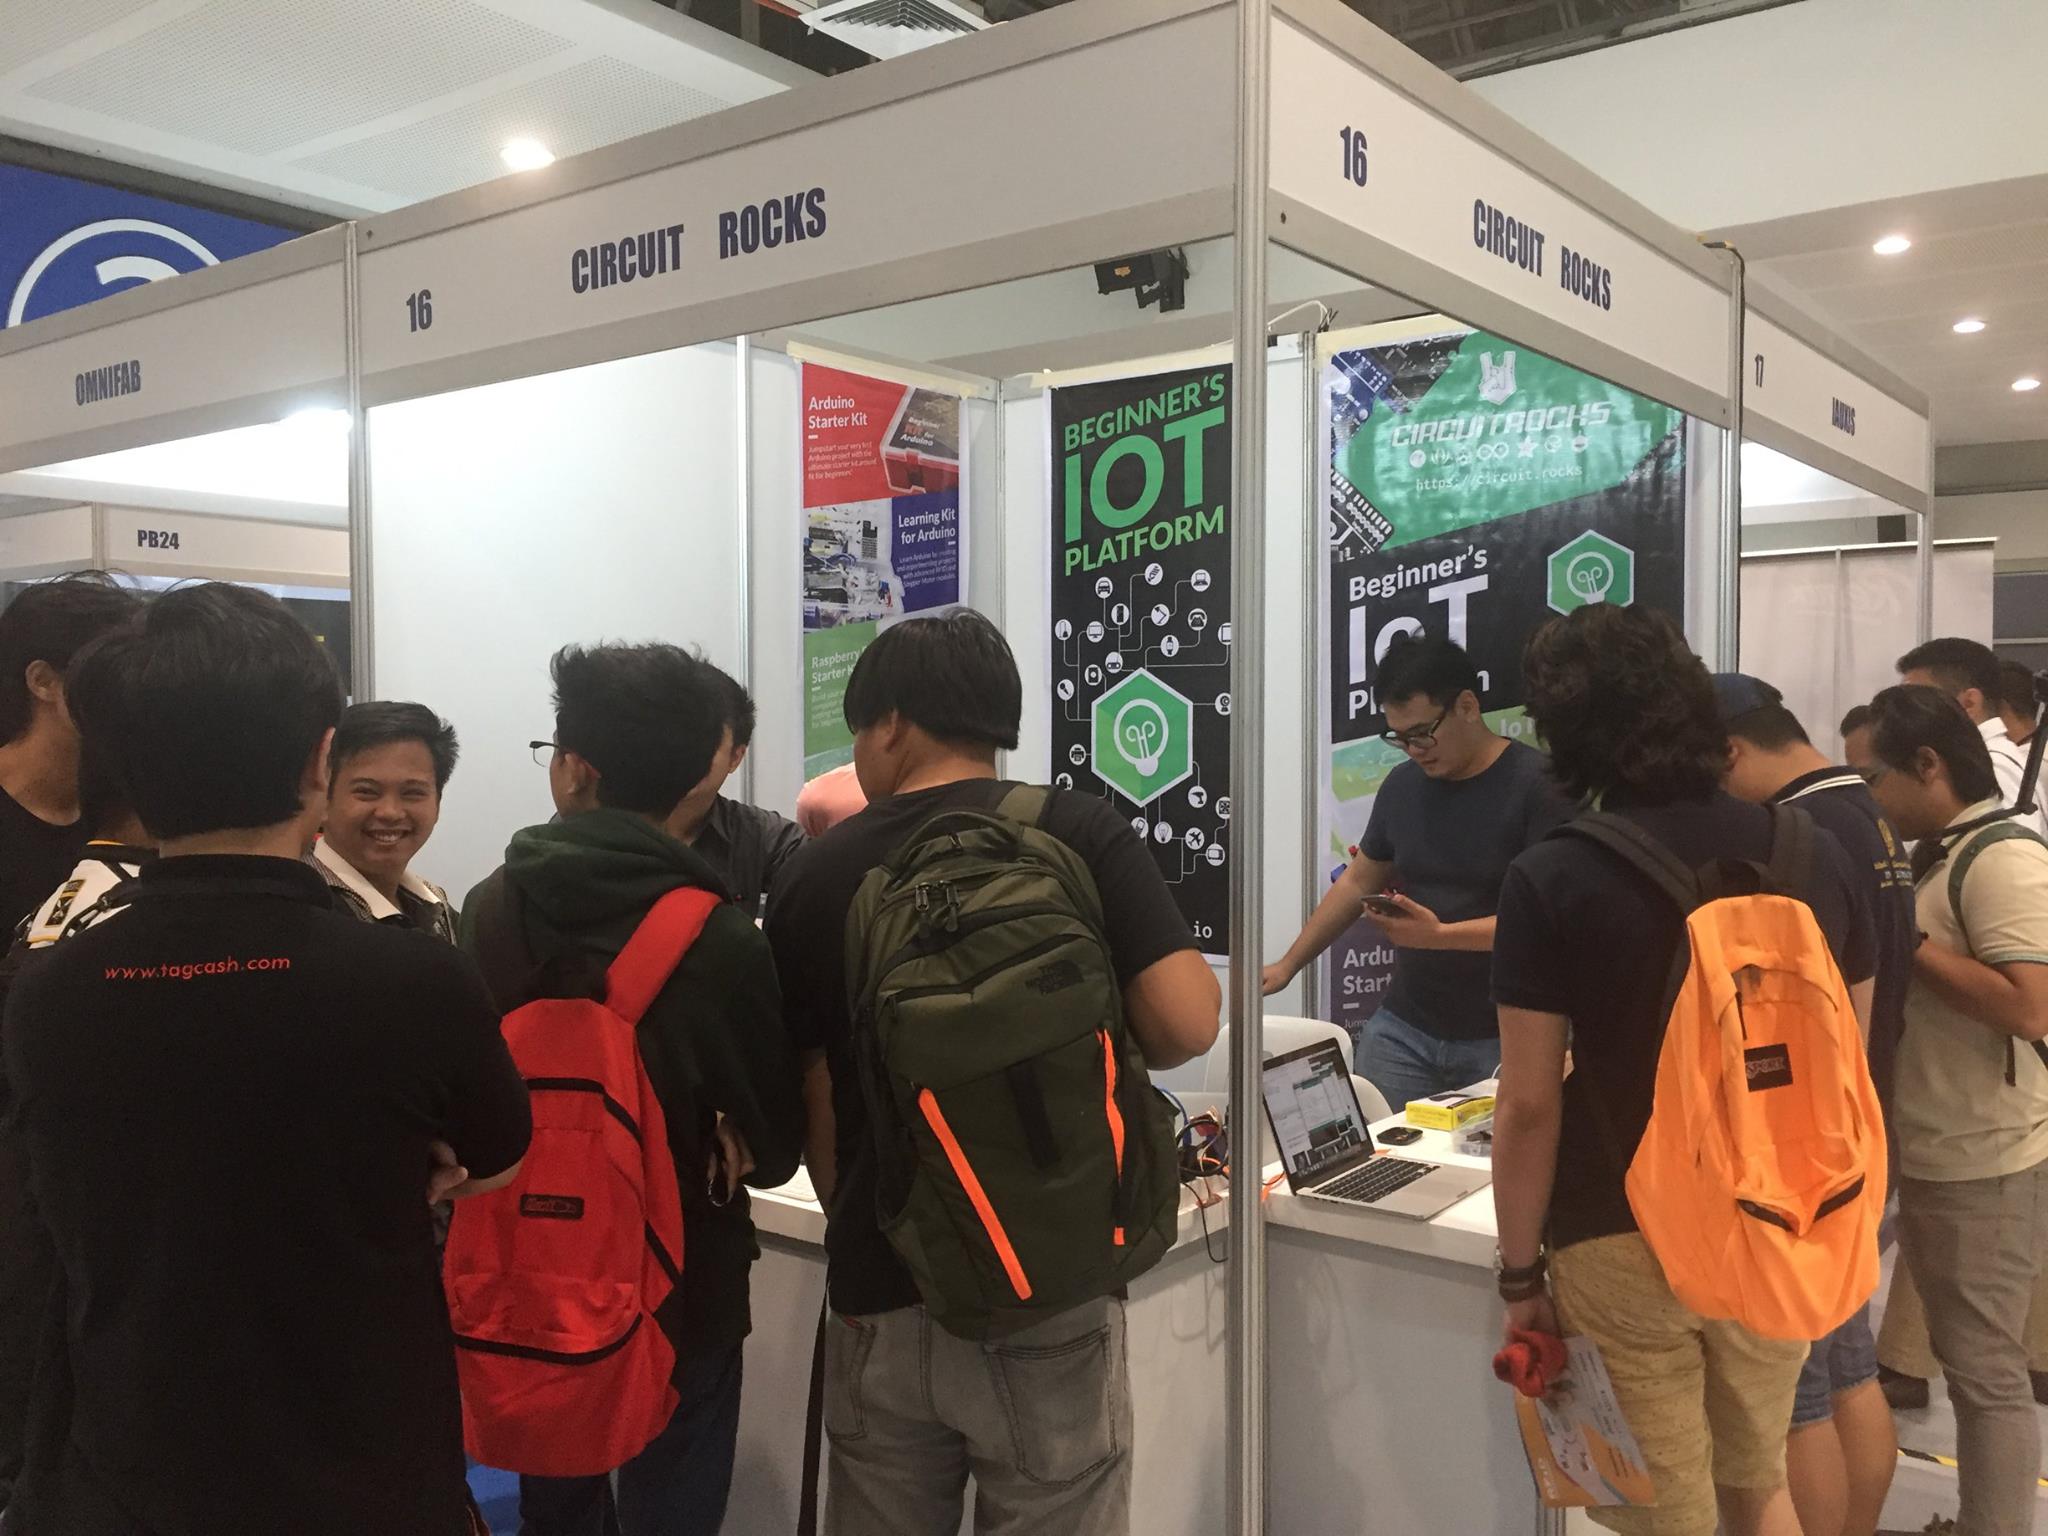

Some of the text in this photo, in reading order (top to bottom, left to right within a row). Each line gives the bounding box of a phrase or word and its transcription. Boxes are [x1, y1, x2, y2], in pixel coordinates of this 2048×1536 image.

[1338, 125, 1368, 188] 16
[571, 186, 827, 295] CIRCUIT ROCKS
[1473, 198, 1612, 311] CIRCUIT ROCKS
[405, 289, 433, 332] 16
[75, 359, 141, 407] OMNIFAB
[809, 396, 855, 410] Arduino
[1064, 373, 1225, 451] BEGINNER'S
[808, 411, 868, 430] Starter Kit
[900, 433, 934, 446] Arduino
[1065, 405, 1225, 544] IOT
[1415, 465, 1584, 491] https://circuit.rocks
[898, 508, 956, 528] Learning Kit
[136, 528, 180, 551] PB24
[901, 526, 956, 545] for Arduino
[1065, 505, 1224, 577] PLATFORM
[1349, 545, 1488, 603] Beginner's
[1348, 574, 1489, 685] IoT
[812, 650, 859, 669] Raspberry
[812, 668, 846, 684] Starter
[1193, 920, 1213, 939] io
[104, 956, 291, 981] www.tagcash.com
[1343, 944, 1395, 969] Ardu
[1343, 973, 1393, 996] Start
